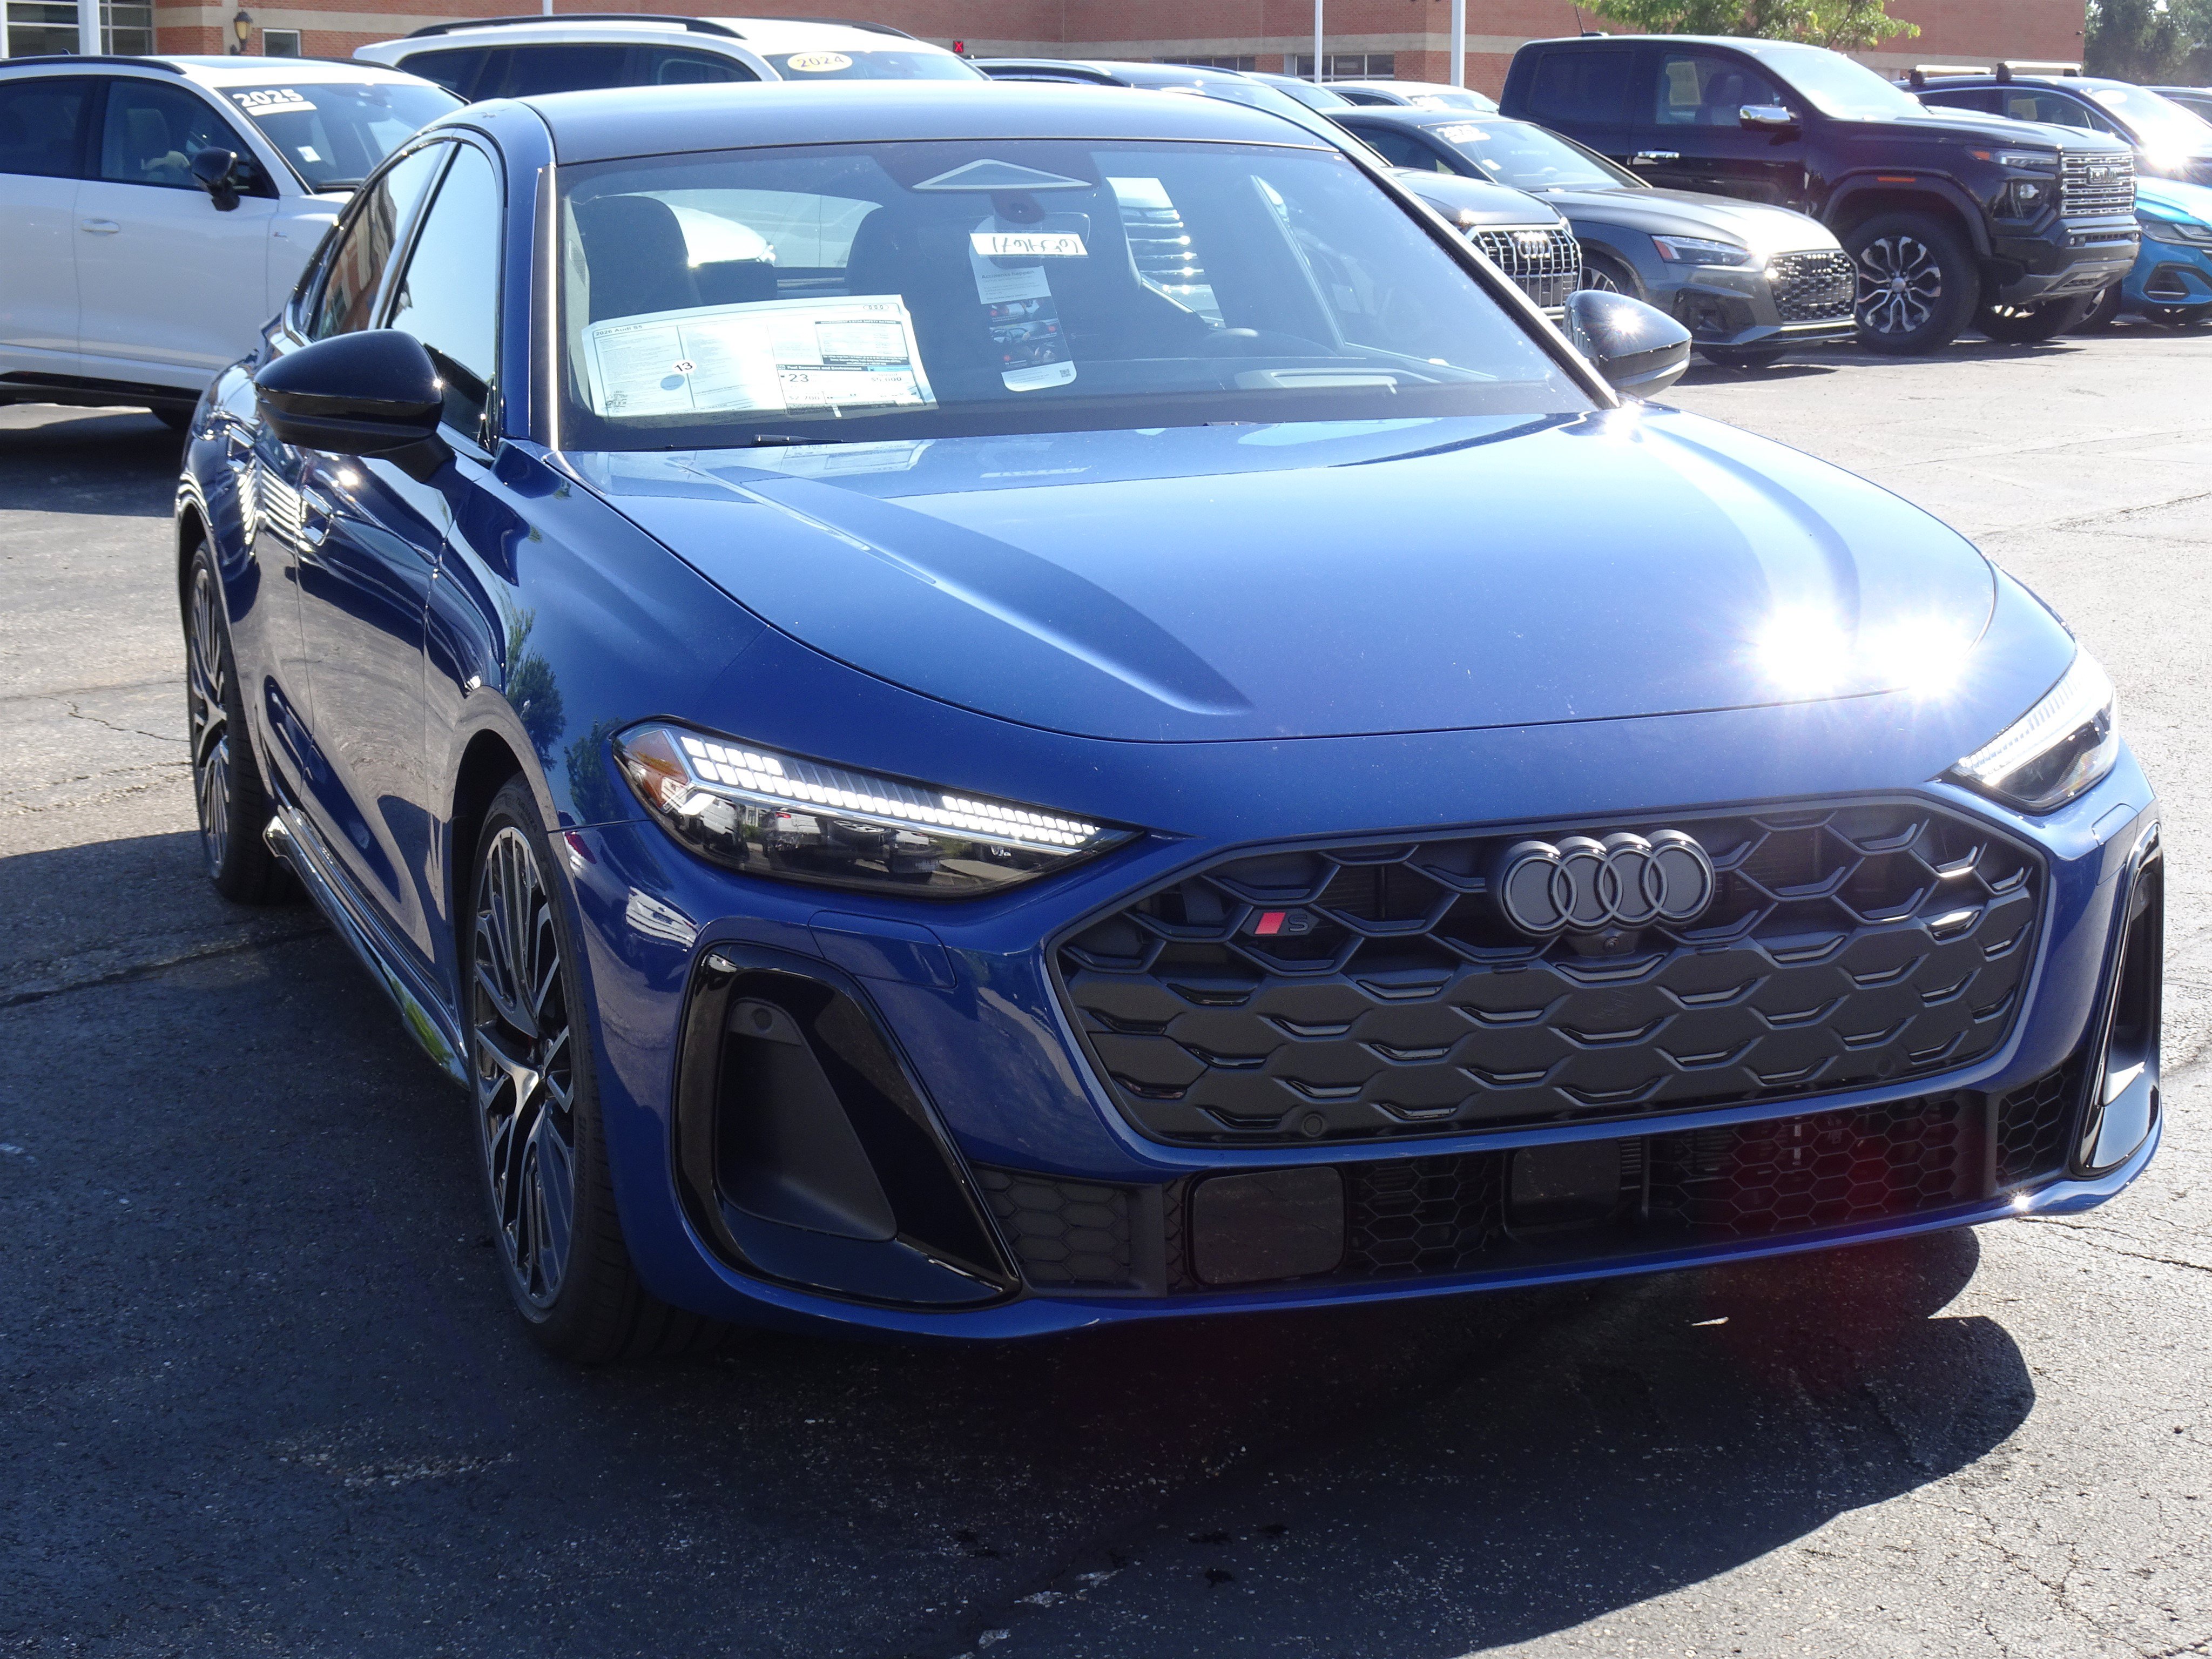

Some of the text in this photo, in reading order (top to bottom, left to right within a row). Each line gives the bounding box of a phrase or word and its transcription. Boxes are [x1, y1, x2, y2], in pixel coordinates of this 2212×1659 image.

[797, 56, 844, 68] 2024
[232, 89, 304, 107] 2025
[675, 362, 693, 372] 13
[789, 374, 809, 382] 23
[1288, 914, 1309, 932] S
